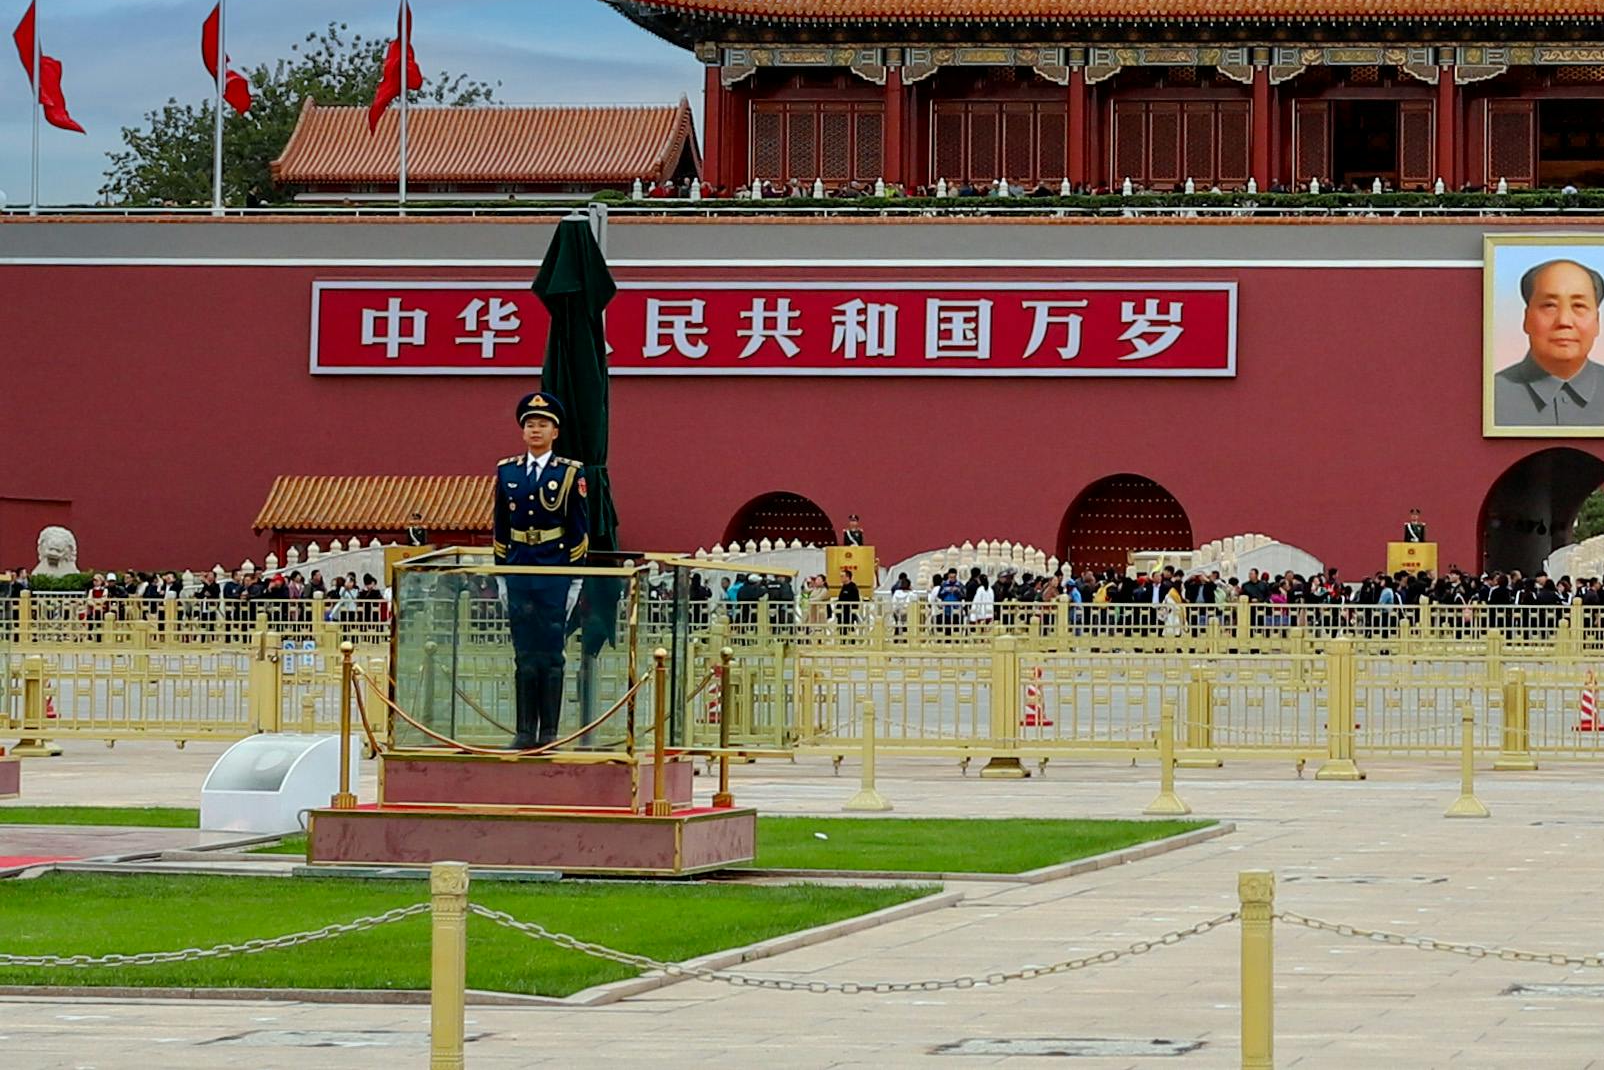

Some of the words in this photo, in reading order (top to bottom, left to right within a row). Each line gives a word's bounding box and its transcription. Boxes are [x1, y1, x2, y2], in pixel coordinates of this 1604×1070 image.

[361, 297, 1185, 360] 中华民共和国万岁
